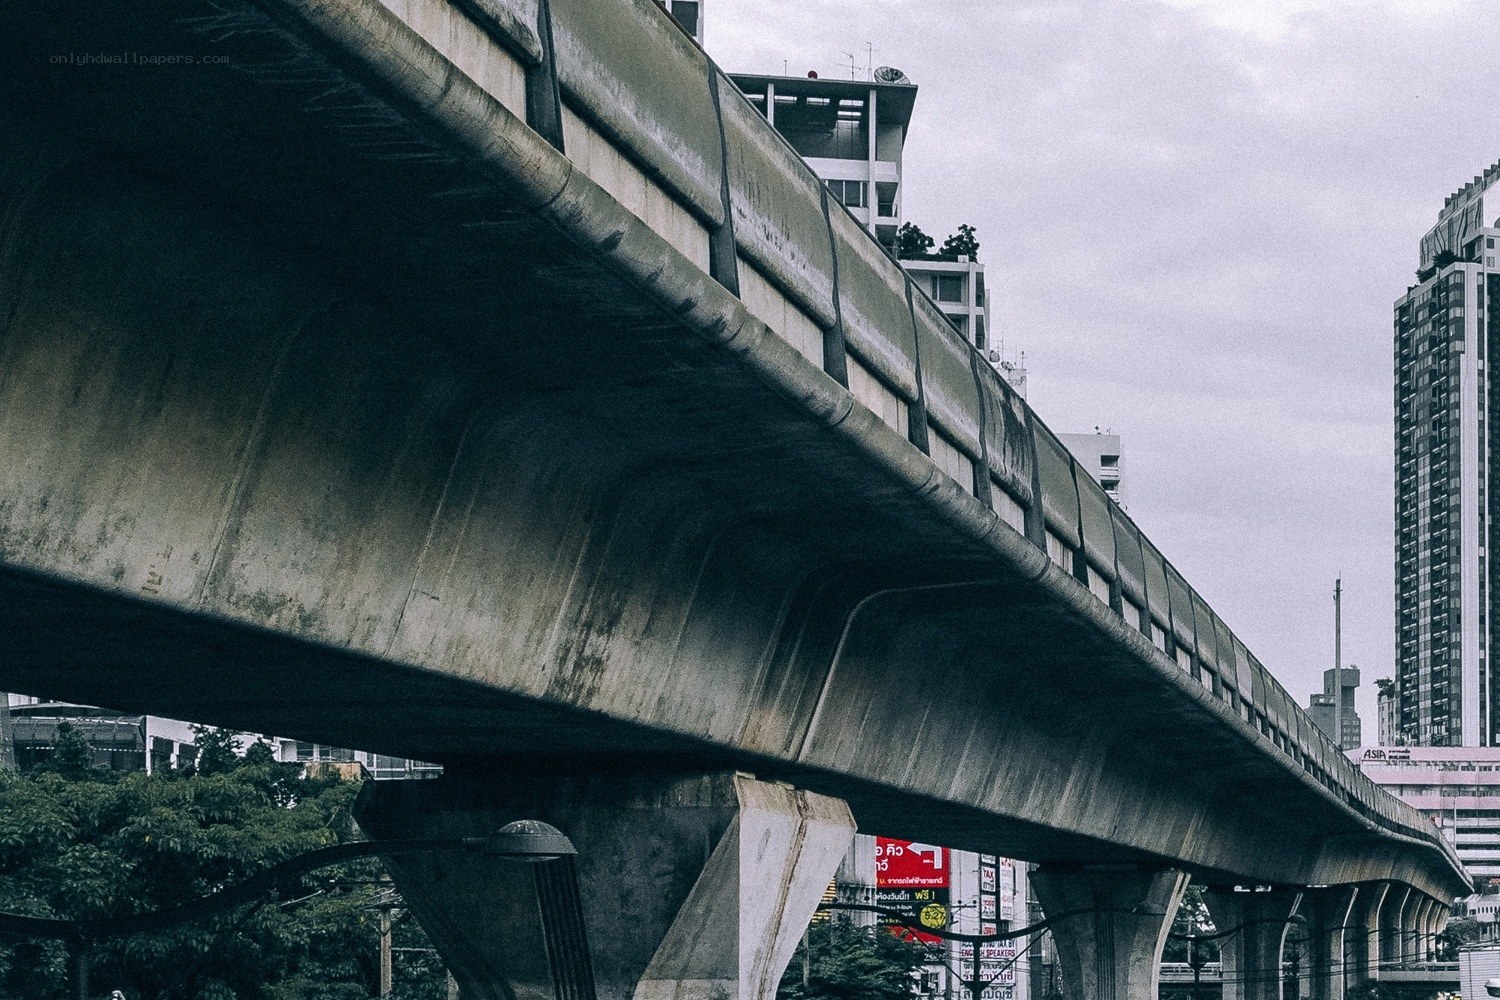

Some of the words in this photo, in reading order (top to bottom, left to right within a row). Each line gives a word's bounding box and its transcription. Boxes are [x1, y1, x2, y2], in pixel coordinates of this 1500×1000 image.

[1363, 749, 1386, 760] ASIA
[983, 869, 994, 878] TAX
[986, 949, 1016, 957] SPEAKERS
